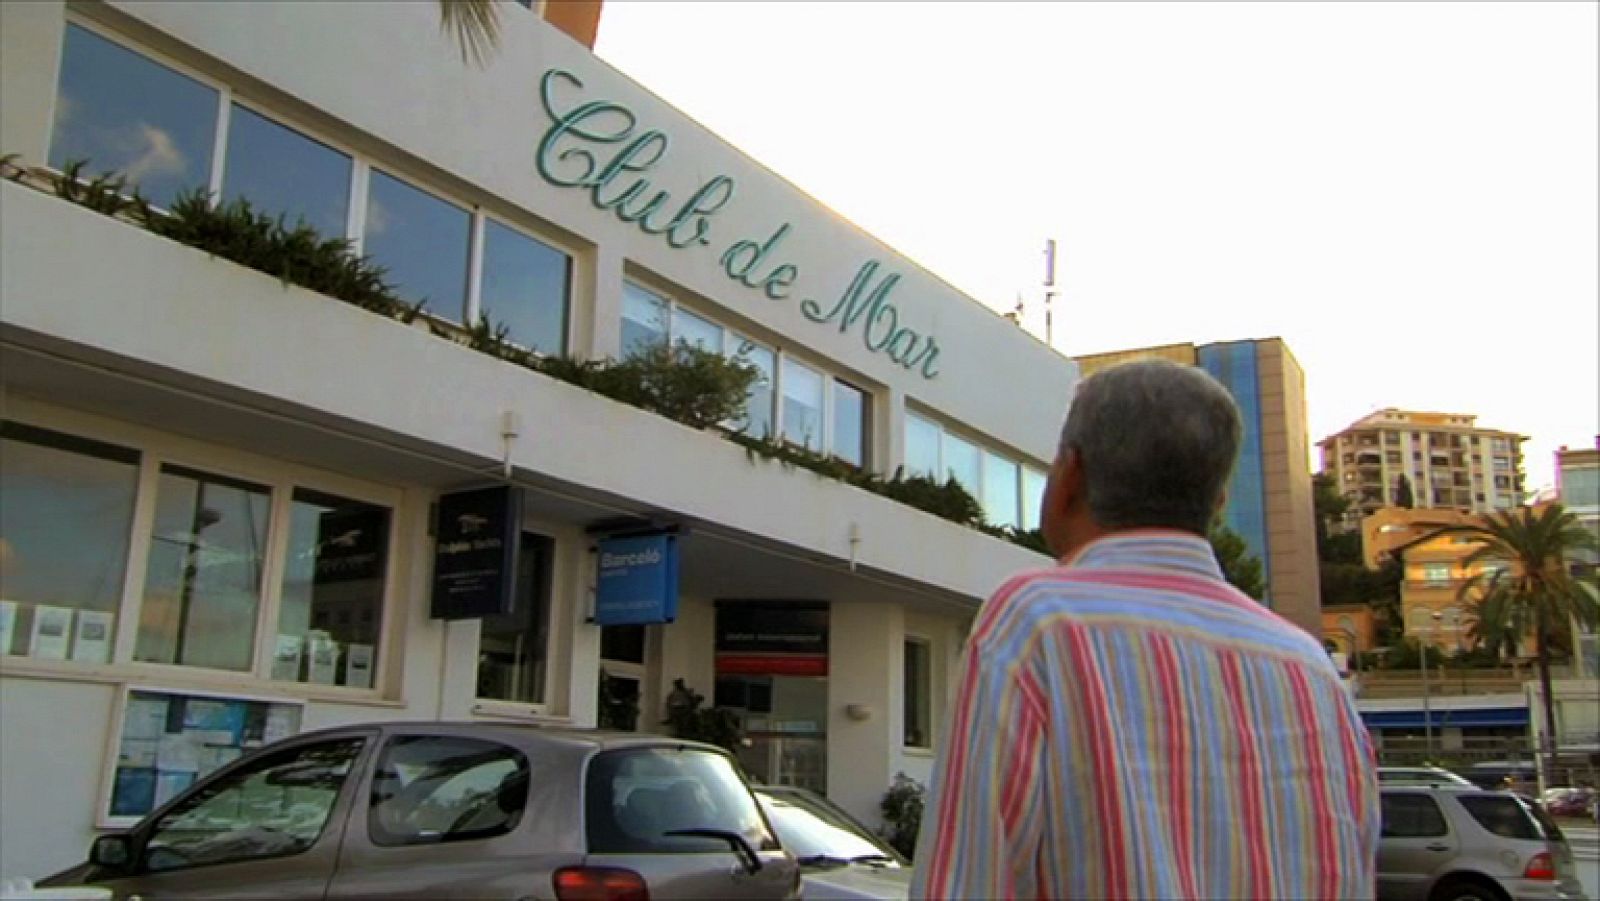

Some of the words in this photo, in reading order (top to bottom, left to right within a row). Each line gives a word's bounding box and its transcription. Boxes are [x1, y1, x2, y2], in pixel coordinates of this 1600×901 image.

[536, 68, 734, 249] Club
[719, 222, 798, 299] de
[801, 259, 939, 379] Mar
